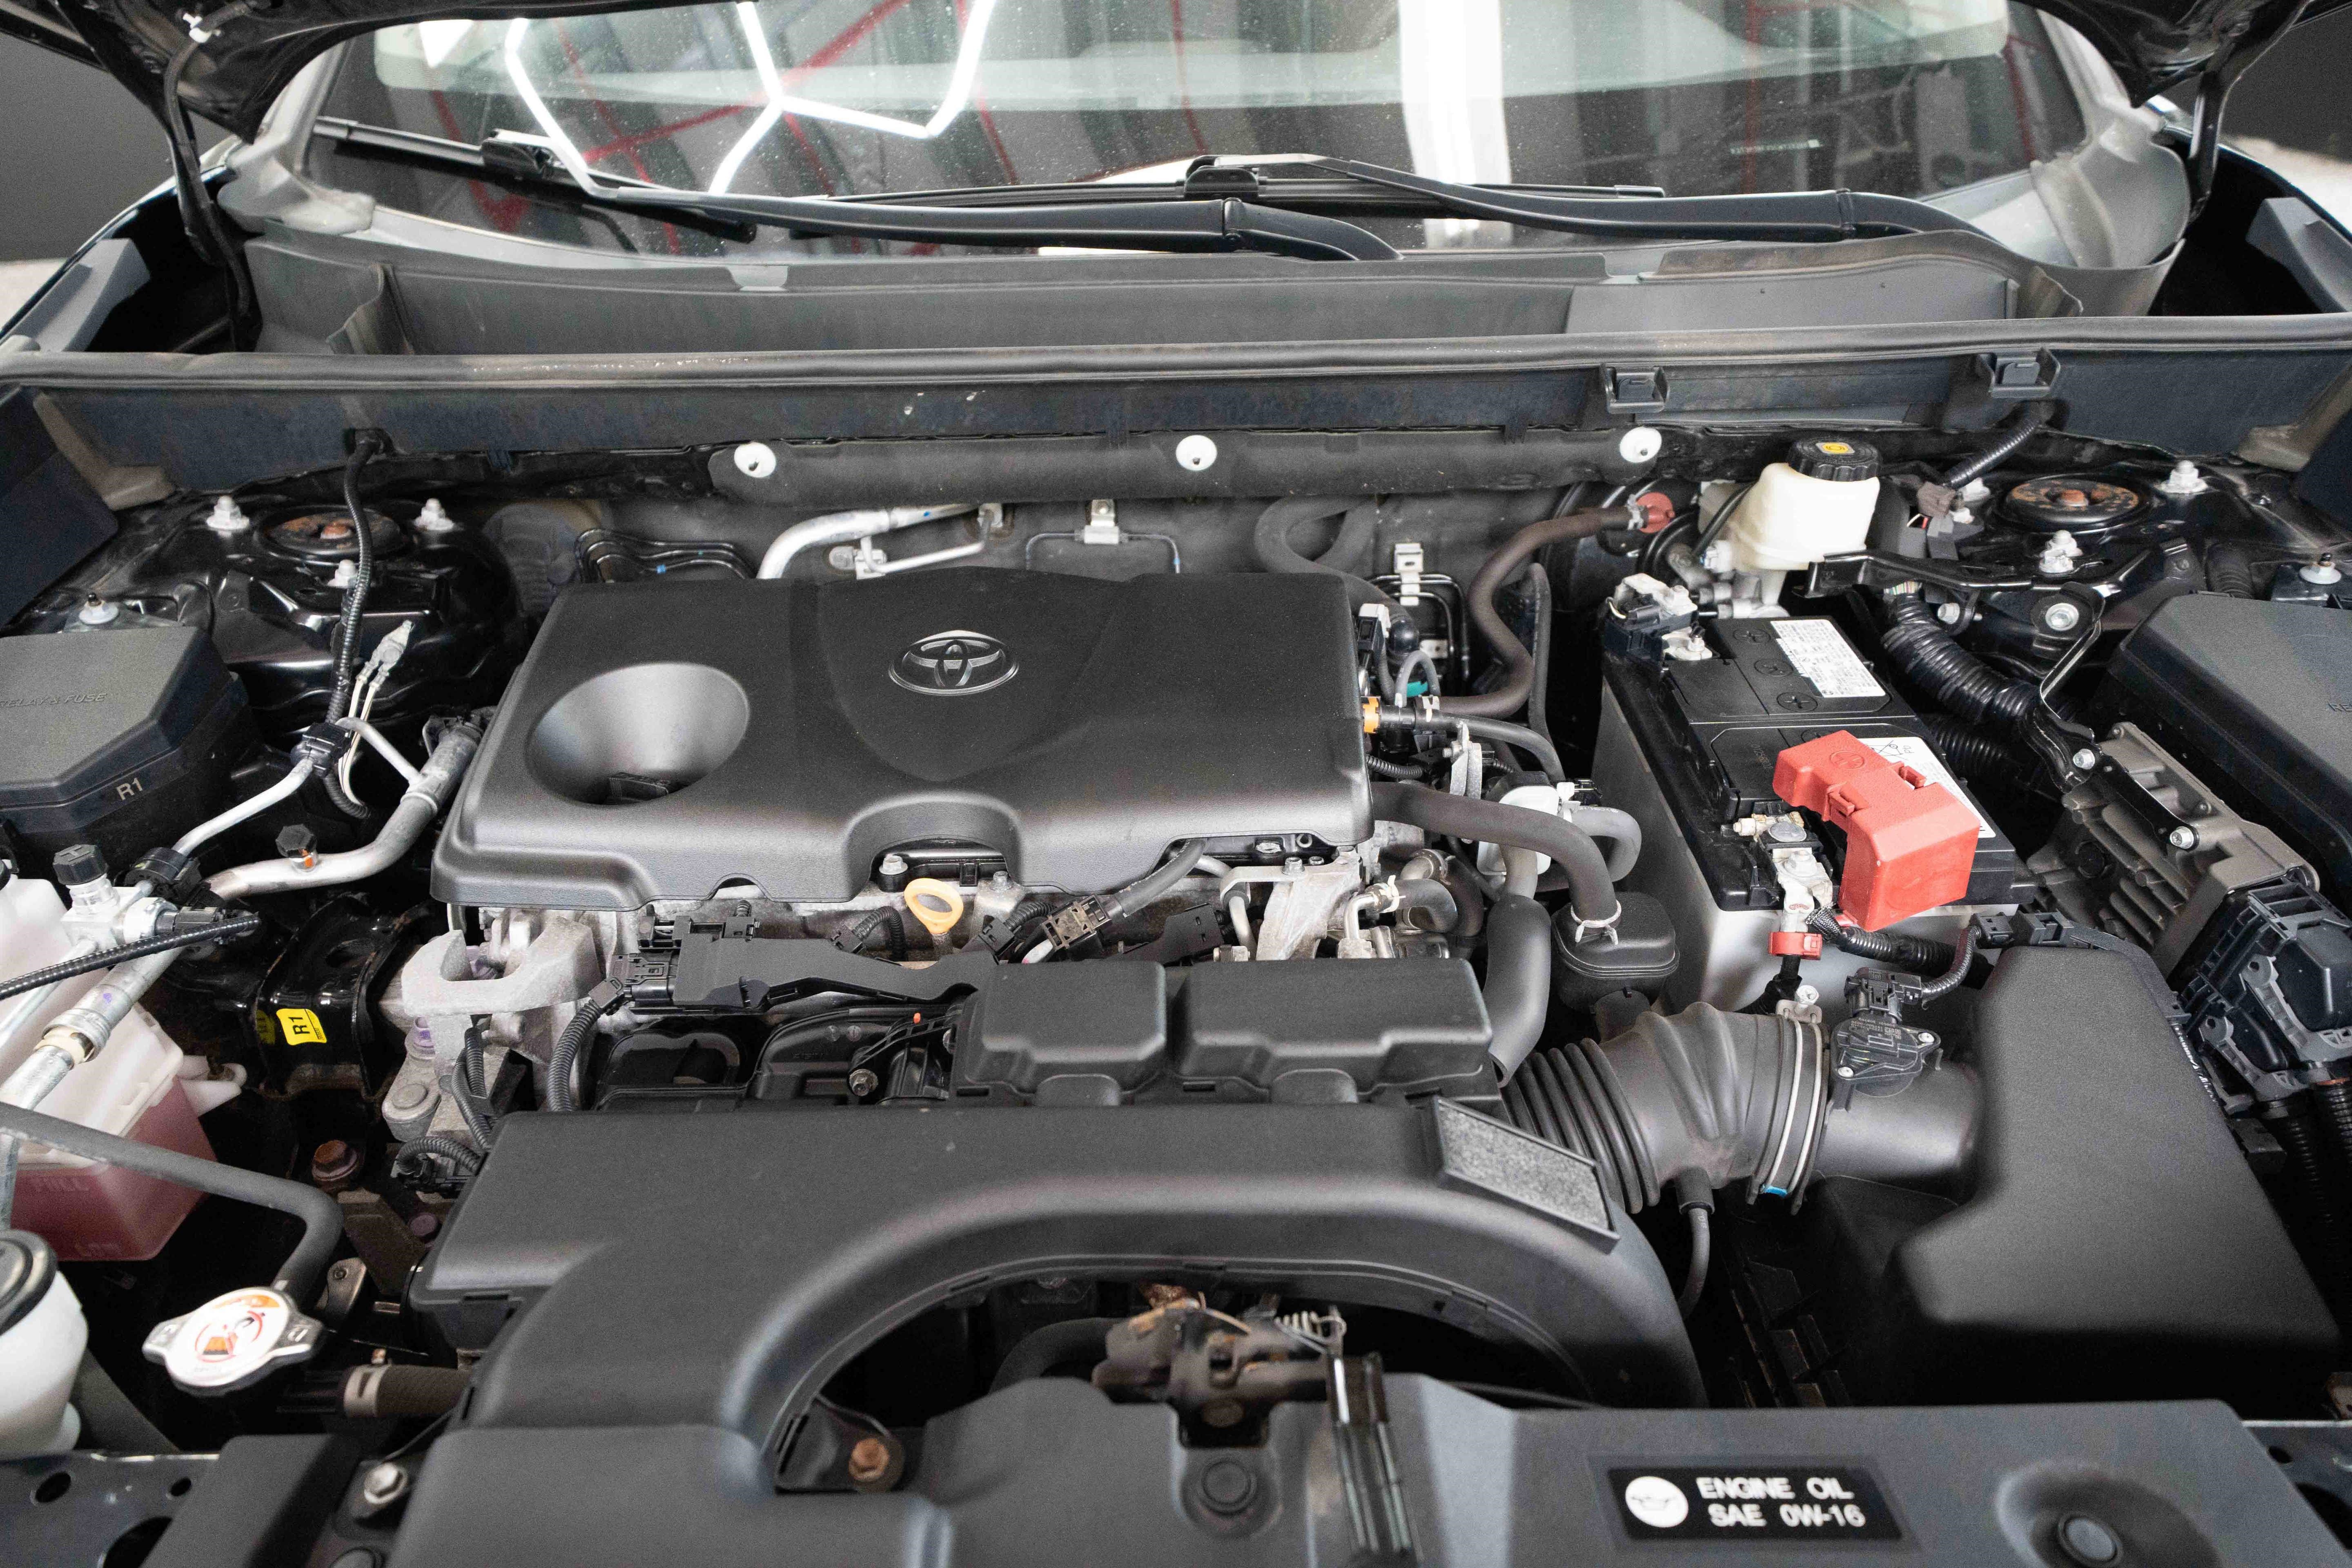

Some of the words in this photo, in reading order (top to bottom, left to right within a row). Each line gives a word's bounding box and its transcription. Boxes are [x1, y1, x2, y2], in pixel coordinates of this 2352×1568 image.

[64, 693, 108, 704] FUSE
[116, 777, 143, 800] R1
[288, 1016, 310, 1035] R1
[1696, 1477, 1795, 1499] ENGINE
[1806, 1477, 1854, 1499] OIL
[1708, 1503, 1767, 1527] SAE
